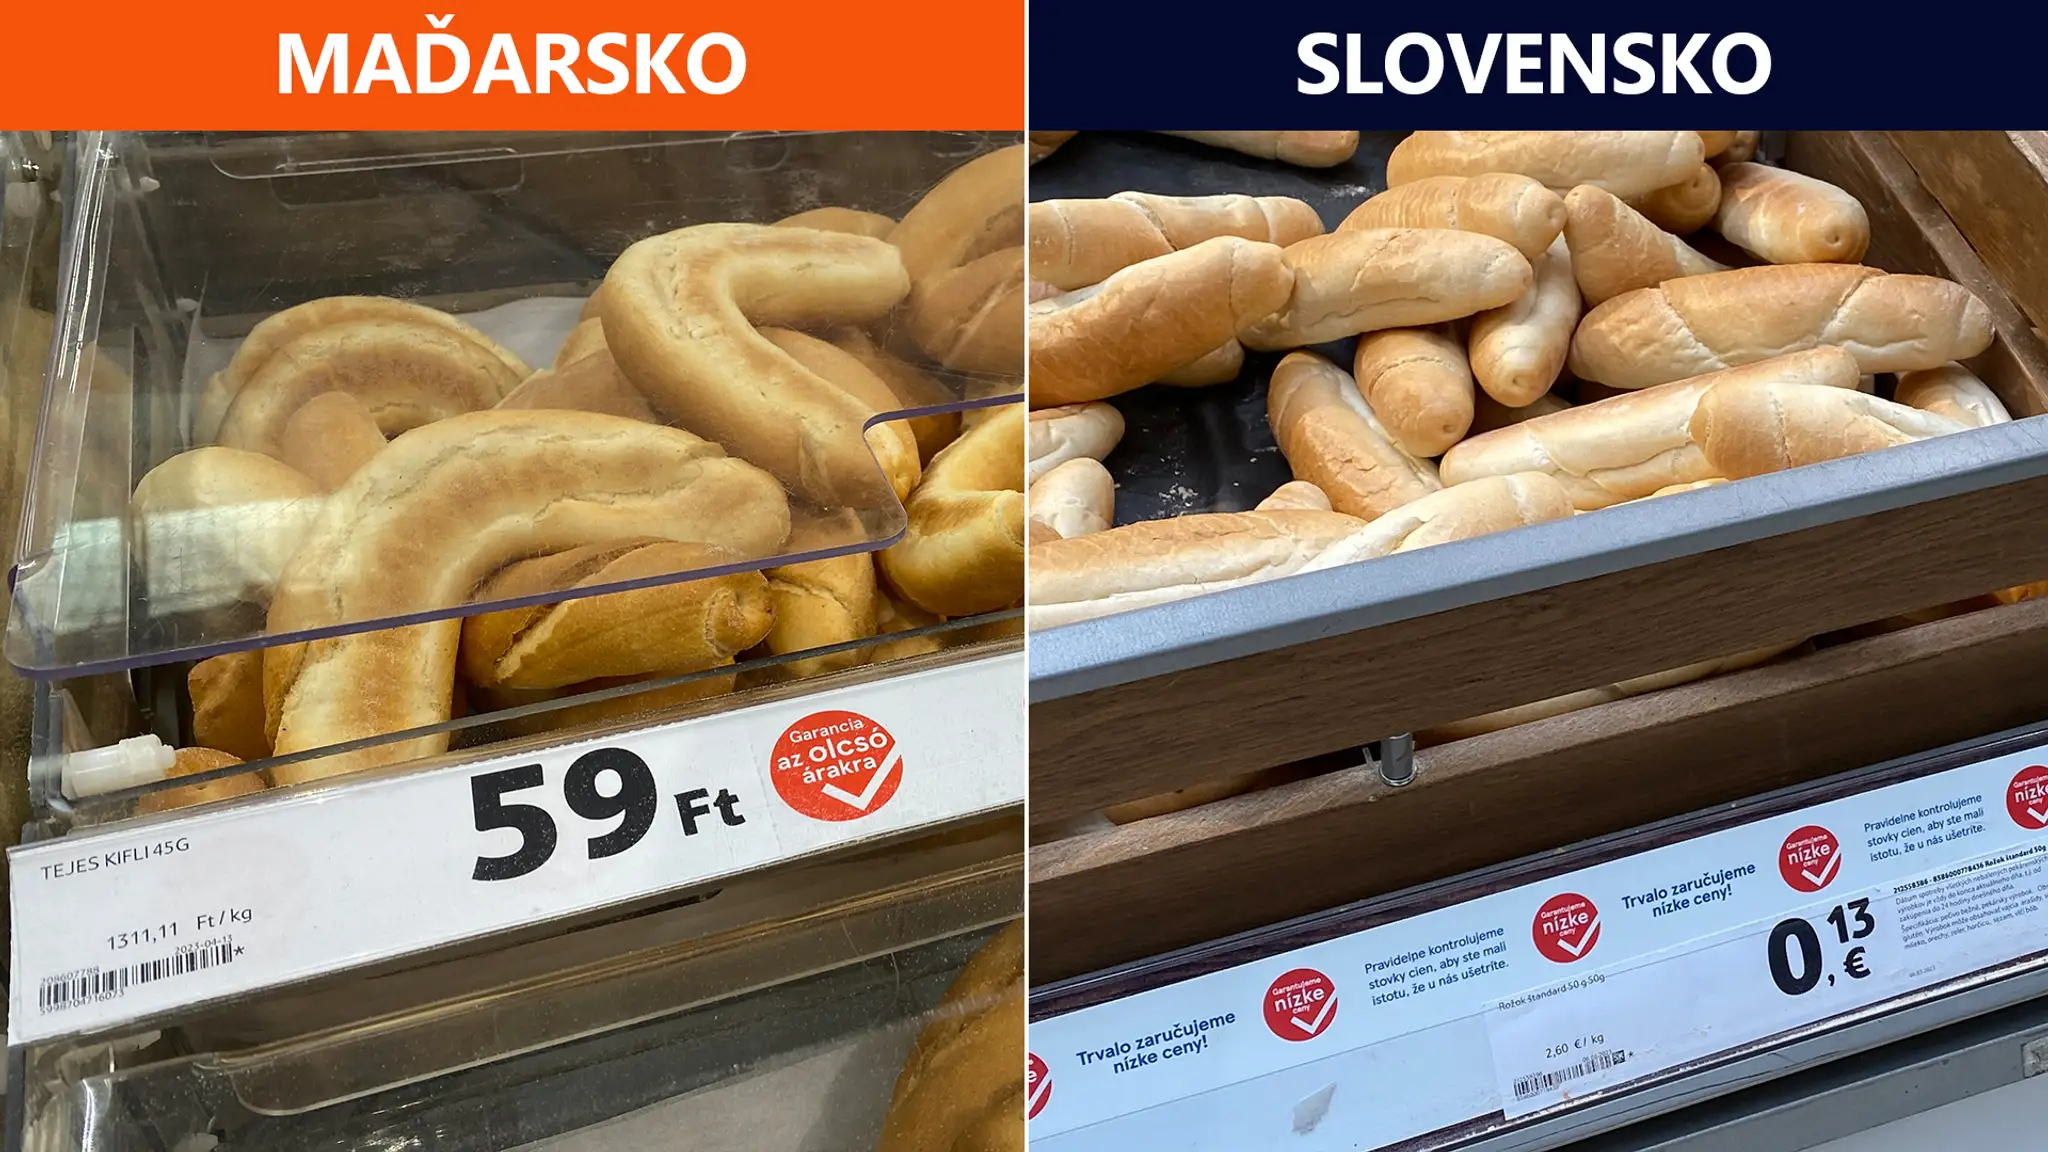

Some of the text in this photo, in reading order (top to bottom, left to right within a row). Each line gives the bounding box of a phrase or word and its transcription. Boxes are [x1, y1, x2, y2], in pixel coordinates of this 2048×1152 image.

[789, 716, 864, 744] Garancia
[777, 725, 888, 770] az olcsó
[801, 753, 877, 785] árakra
[2013, 774, 2048, 788] Garantujem
[470, 747, 746, 881] 59 Ft
[1864, 794, 1983, 833] Pravidelne kontrolujeme
[1867, 808, 1985, 849] stovky cien, aby ste mali
[1786, 834, 1828, 850] Garantujeme
[1788, 843, 1831, 866] nízke
[1870, 823, 1986, 863] istotu, že u nás ušetríte.
[41, 837, 190, 880] TEJES KIFLI 45G
[1803, 858, 1819, 869] ceny
[1621, 863, 1756, 910] Trvalo zaručujeme
[1652, 884, 1732, 918] nízke ceny!
[1540, 901, 1586, 919] Garantujeme
[1543, 911, 1589, 936] nízke
[107, 921, 179, 952] 1311,11
[196, 912, 215, 931] Ft
[230, 907, 253, 928] kg
[175, 934, 233, 956] 2023-04-13
[1428, 927, 1505, 957] kontrolujeme
[1559, 927, 1576, 938] ceny
[1368, 941, 1507, 991] stovky cien, aby ste mali
[1272, 977, 1322, 996] Garantujeme
[1372, 960, 1510, 1007] istotu, že u nás ušetríte.
[1498, 996, 1526, 1012] Rožok
[1527, 984, 1567, 1004] štandard
[1588, 972, 1606, 985] 50g
[1274, 988, 1325, 1013] nízke
[1292, 1004, 1311, 1014] ceny
[1076, 1010, 1236, 1068] Trvalo zaručujeme
[1113, 1035, 1209, 1075] nízke ceny!
[1545, 1043, 1569, 1060] 2,60
[1590, 1033, 1605, 1046] kg
